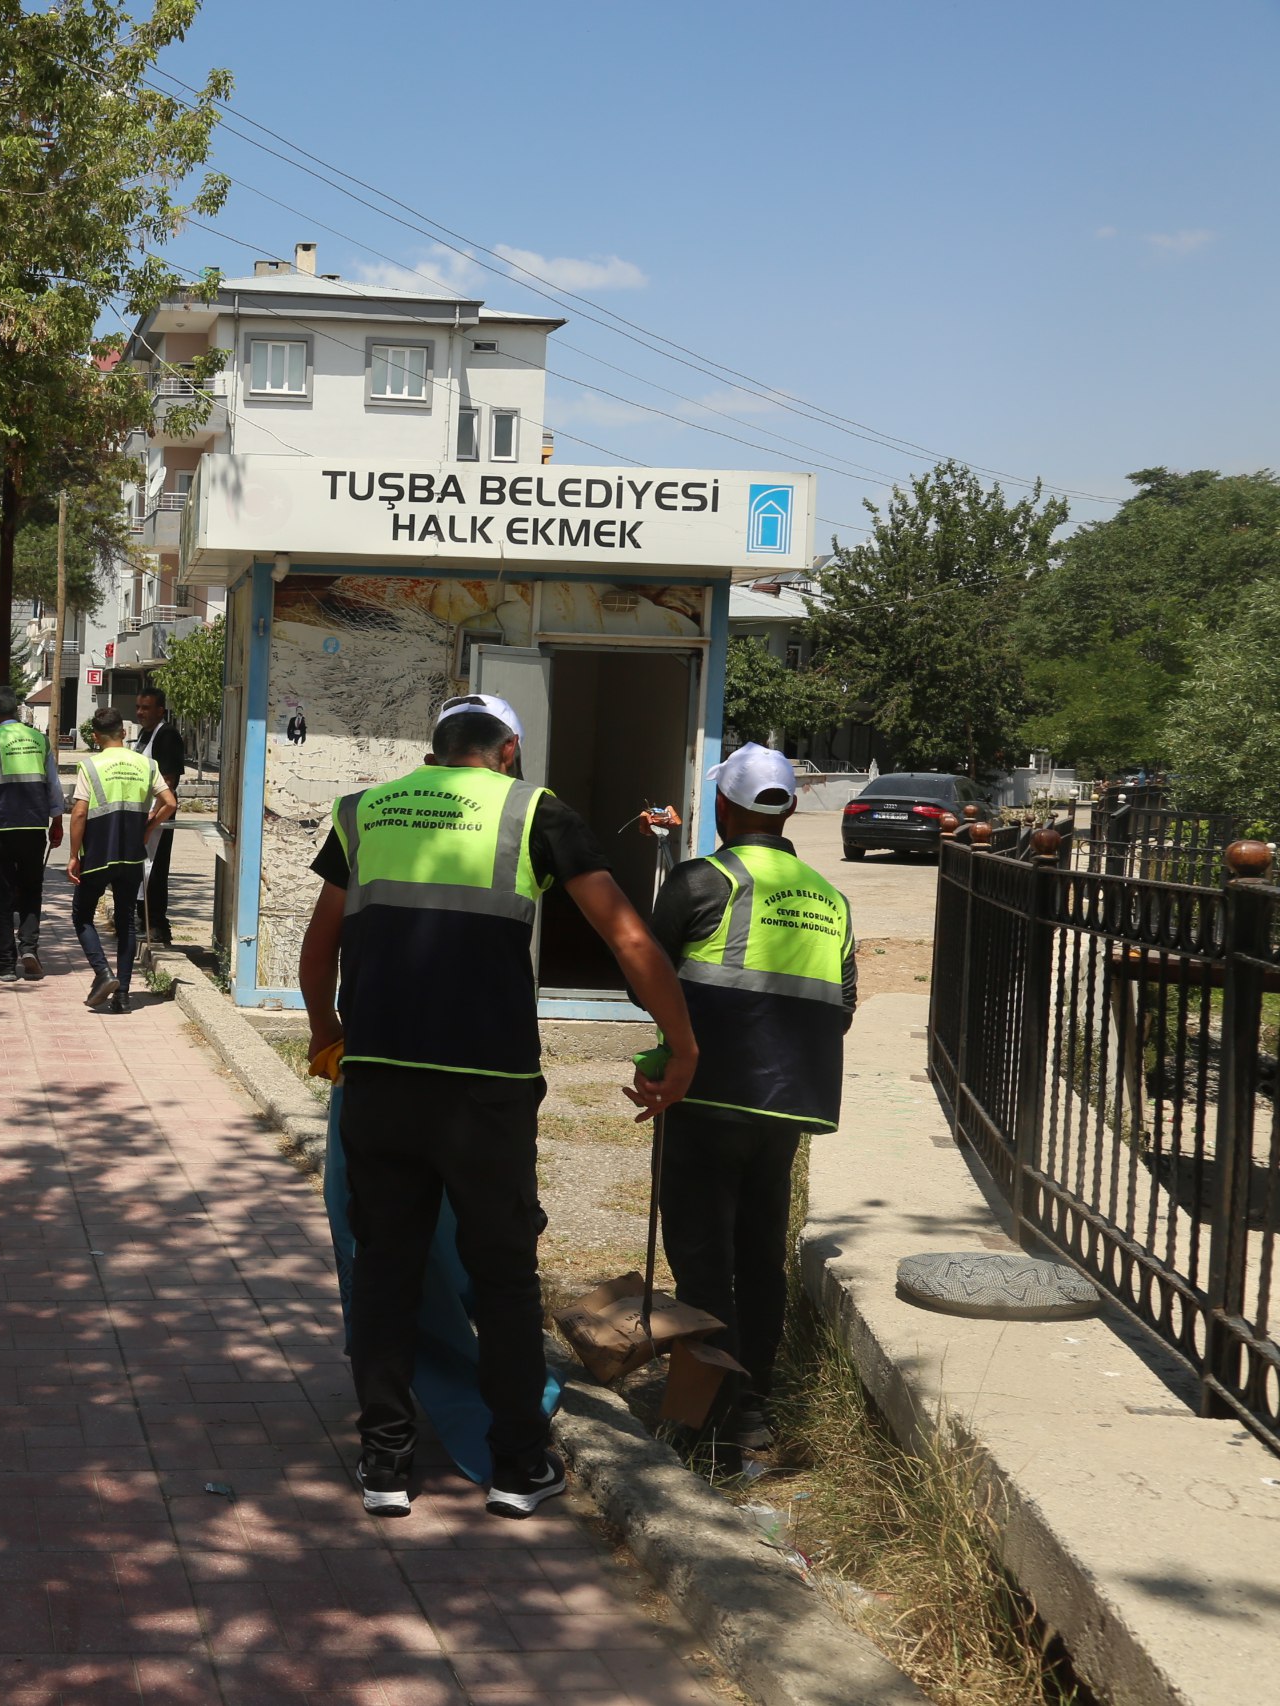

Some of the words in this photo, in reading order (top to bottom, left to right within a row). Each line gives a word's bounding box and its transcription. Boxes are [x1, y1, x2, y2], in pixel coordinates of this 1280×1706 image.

[321, 470, 466, 510] TUŞBA
[479, 474, 719, 513] BELEDİYESİ
[391, 512, 493, 544] HALK
[506, 516, 644, 549] EKMEK
[367, 790, 409, 810] TUŞBA
[413, 789, 482, 812] BELEDİYESİ
[381, 807, 413, 817] ÇEVRE
[415, 808, 464, 819] KORUMA
[363, 818, 409, 832] KONTROL
[411, 818, 483, 832] MÜDÜRLÜĞÜ
[764, 889, 794, 907] TUŞBA
[760, 917, 799, 929] KONTROL
[776, 907, 801, 918] ÇEVRE
[802, 910, 834, 925] KORUMA
